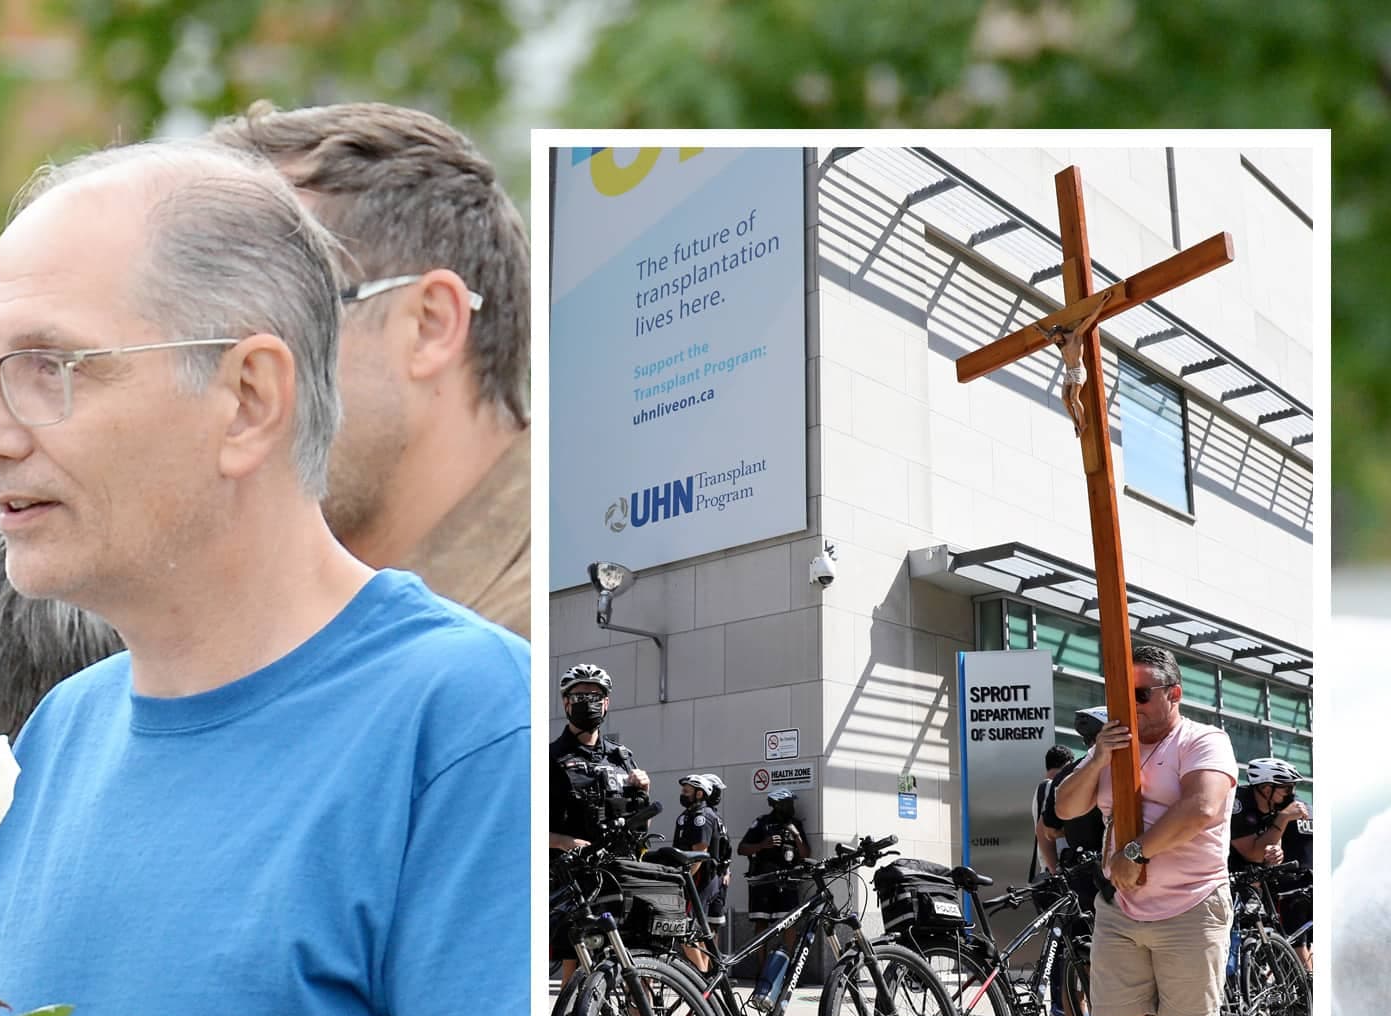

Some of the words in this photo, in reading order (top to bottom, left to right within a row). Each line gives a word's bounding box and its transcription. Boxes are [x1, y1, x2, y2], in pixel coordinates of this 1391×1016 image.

[636, 256, 669, 280] The
[673, 228, 730, 264] future
[735, 208, 757, 236] of
[635, 235, 780, 309] transplantation
[635, 309, 674, 337] lives
[679, 290, 726, 319] here.
[633, 351, 685, 379] Support
[687, 342, 710, 359] the
[633, 367, 701, 402] Transplant
[703, 345, 768, 377] Program:
[633, 388, 715, 425] uhnliveon.ca
[630, 475, 694, 528] UHN
[695, 459, 767, 489] Transplant
[696, 486, 754, 512] Program
[969, 684, 1031, 703] SPROTT
[970, 706, 1051, 722] DEPARTMENT
[970, 728, 986, 742] OF
[988, 726, 1045, 741] SURGERY
[771, 769, 794, 779] HEALTH
[794, 767, 812, 777] ZONE
[654, 921, 686, 933] POLICE
[787, 946, 809, 993] TORONTO
[1042, 940, 1059, 980] TORONTO
